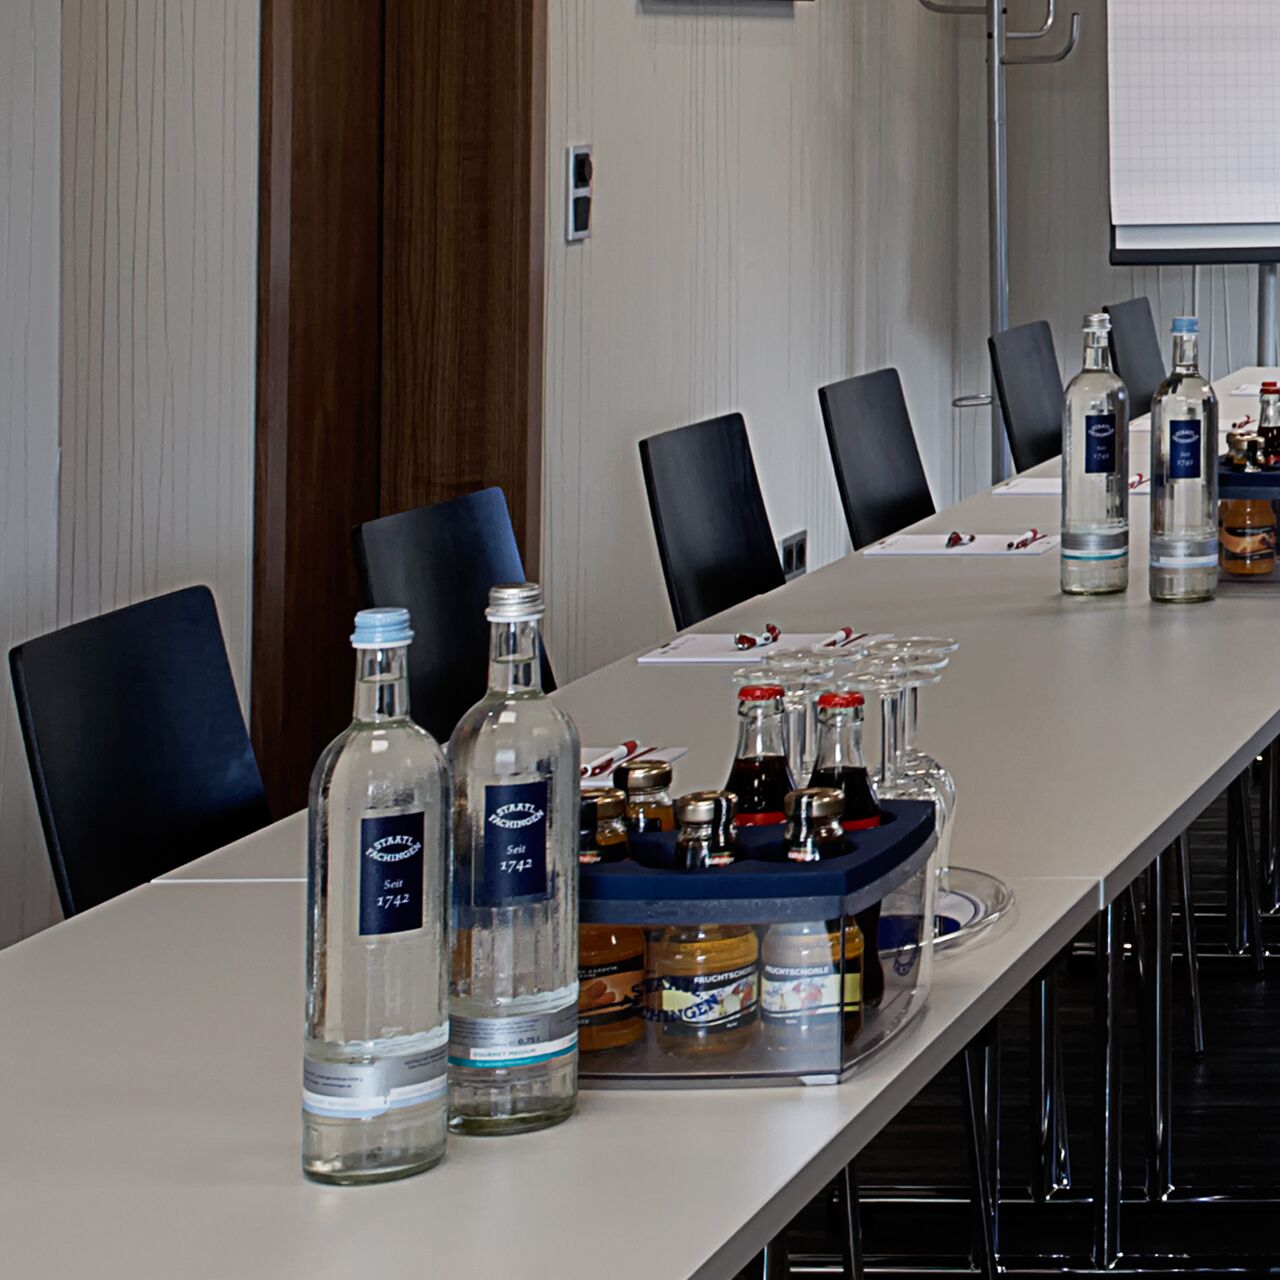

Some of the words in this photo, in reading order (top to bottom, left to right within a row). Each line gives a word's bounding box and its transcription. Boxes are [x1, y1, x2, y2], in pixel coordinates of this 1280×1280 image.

[496, 803, 536, 817] STAATL
[488, 809, 545, 829] FACHINGEN
[374, 835, 414, 850] STAATL
[506, 844, 526, 855] Seit
[365, 842, 421, 862] FACHINGEN
[500, 859, 533, 873] 1742
[384, 879, 403, 890] Seit
[377, 894, 410, 909] 1742
